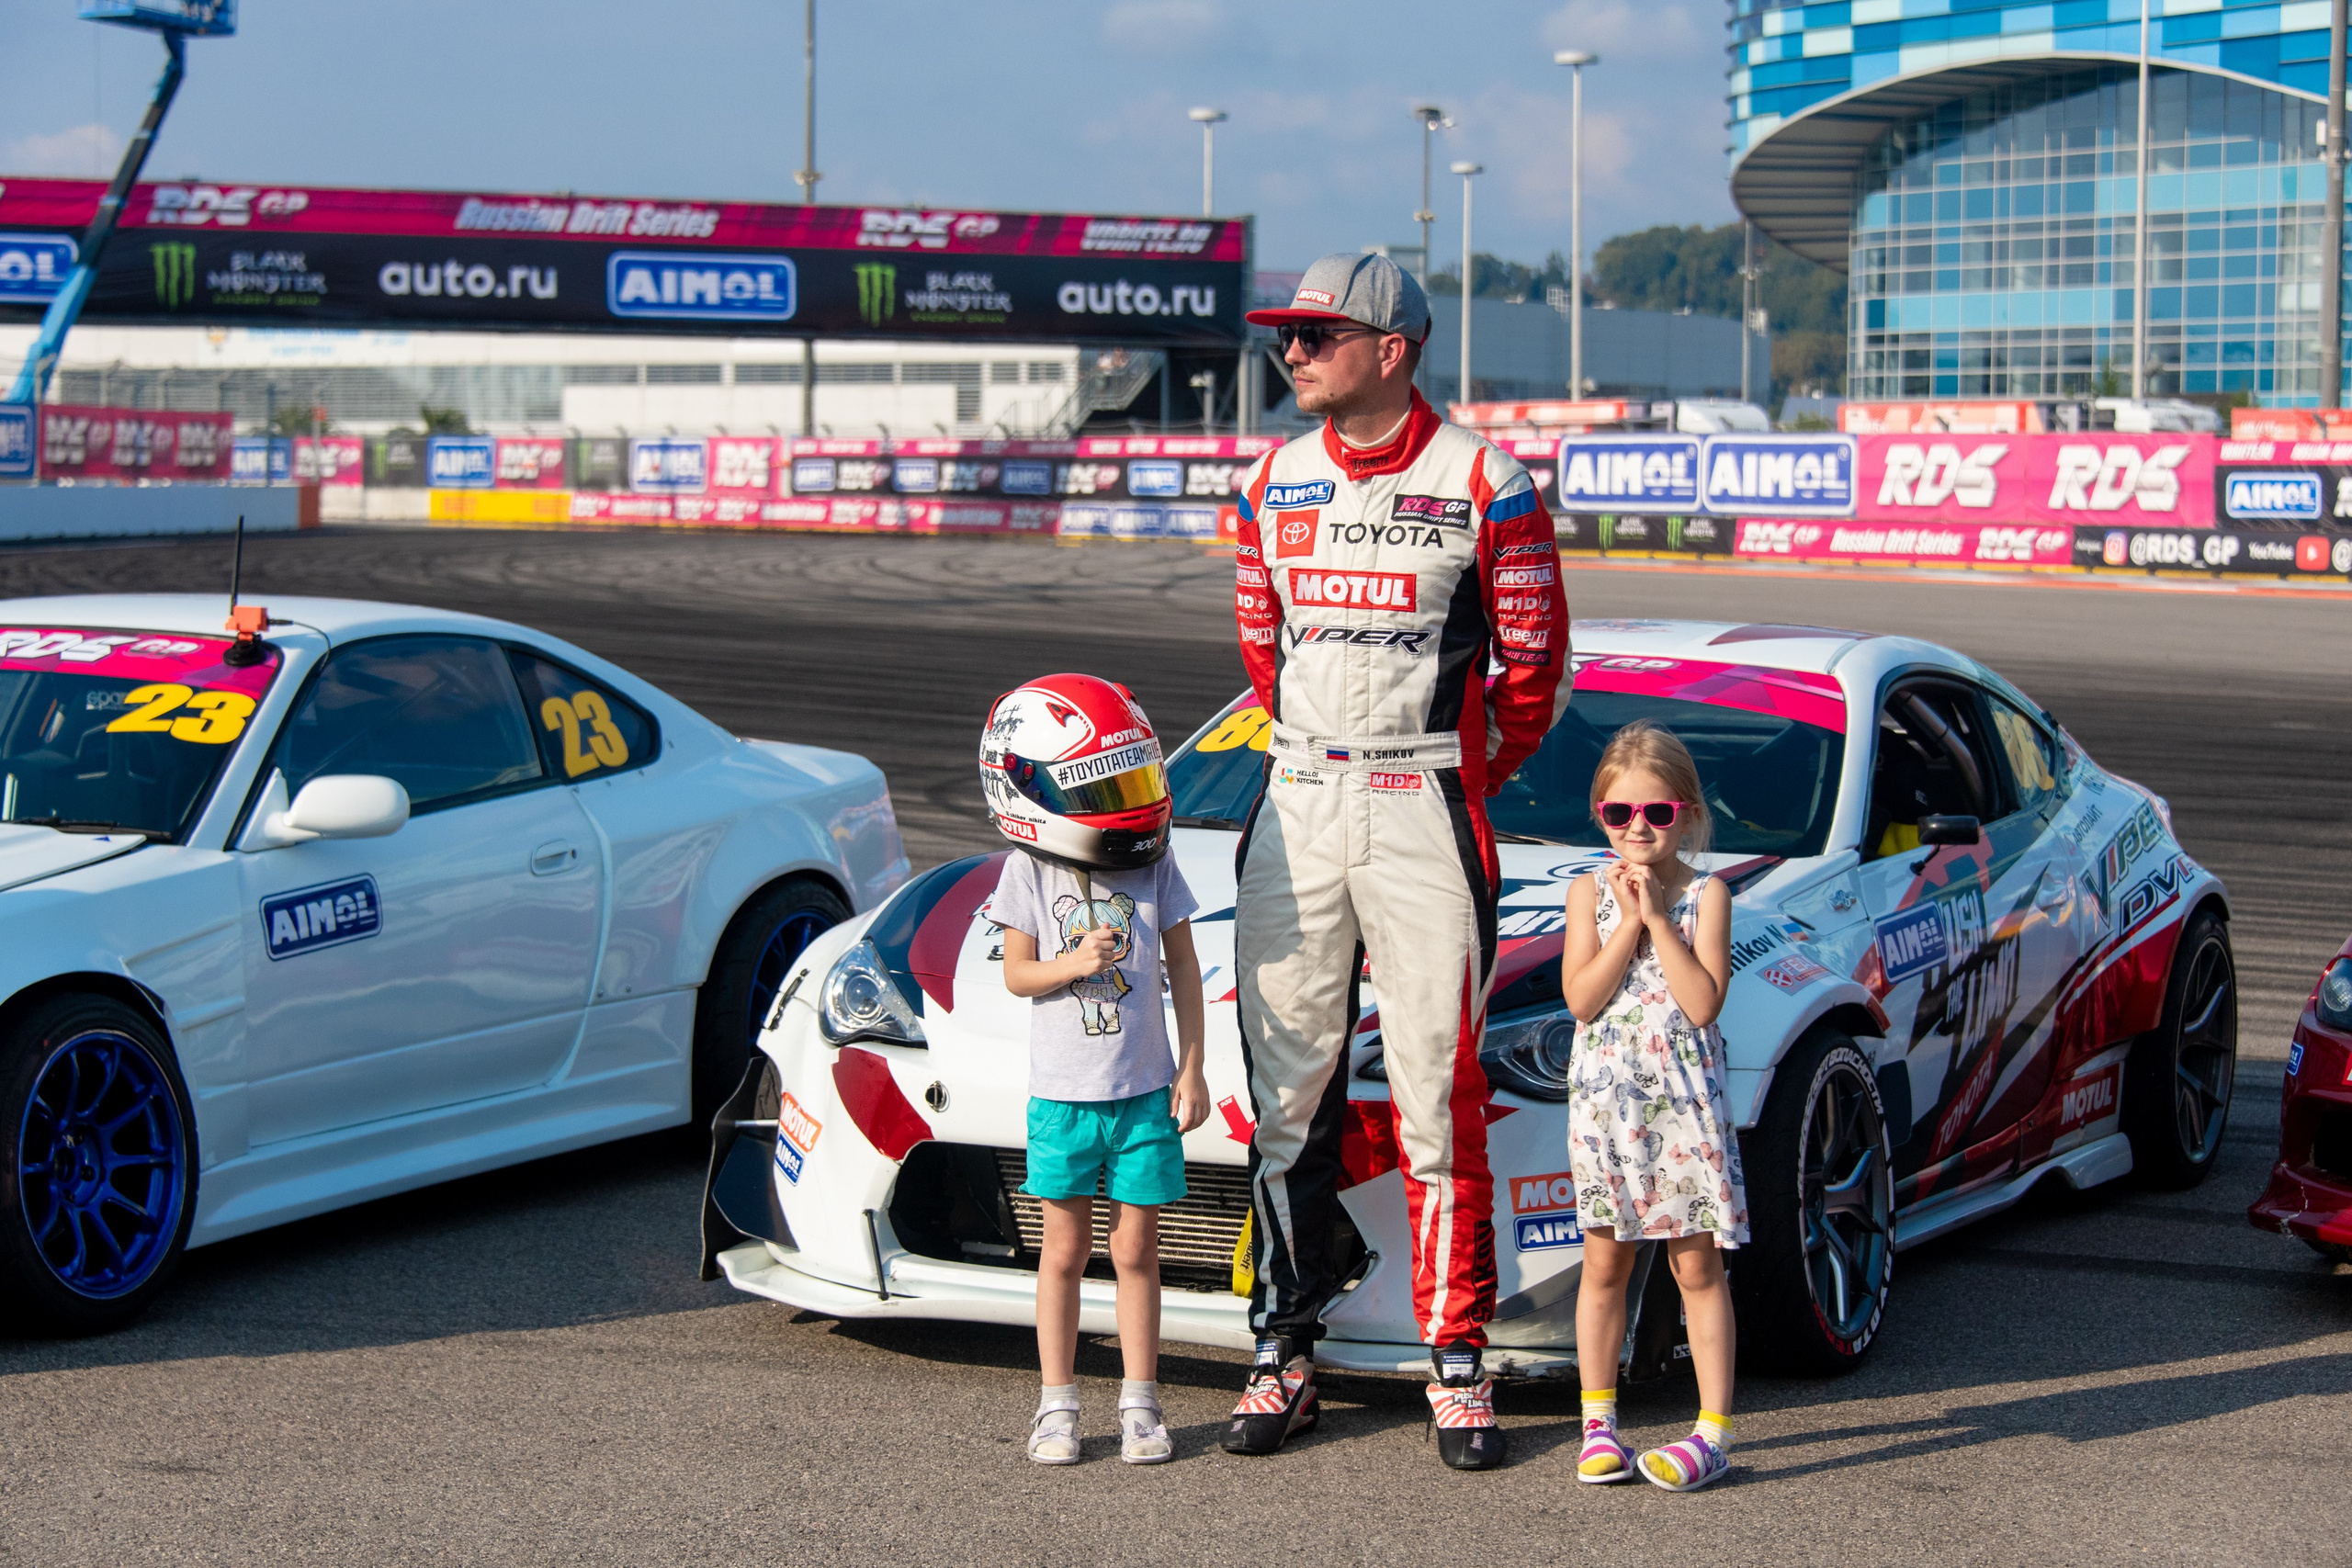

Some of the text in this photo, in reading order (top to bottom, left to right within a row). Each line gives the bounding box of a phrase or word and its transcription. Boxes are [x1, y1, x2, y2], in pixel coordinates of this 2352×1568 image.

[147, 187, 310, 225] RDS GP
[454, 197, 719, 237] Russian Drift Series
[856, 210, 1001, 248] RDS GP
[379, 258, 558, 299] auto.ru
[618, 268, 785, 306] AIMOL
[1057, 279, 1216, 317] auto.ru
[1297, 289, 1333, 306] MOTUL
[1351, 456, 1388, 471] freem
[1565, 451, 1696, 497] AIMOL
[1708, 452, 1849, 499] AIMOL
[1877, 443, 2009, 507] RDS
[2048, 445, 2192, 512] RDS
[1266, 486, 1328, 503] AIMOL
[1398, 497, 1469, 516] RDS GP
[2230, 481, 2315, 510] AIMOL
[1329, 522, 1443, 549] TOYOTA
[1423, 513, 1442, 524] DRIFT
[1443, 517, 1466, 525] SERIES
[1493, 542, 1554, 560] VIPER
[1739, 523, 1822, 553] RDS GP
[1830, 527, 1965, 556] Russian Drift Series
[1975, 526, 2067, 561] RDS GP
[2129, 532, 2240, 570] @RDS_GP
[2248, 541, 2295, 561] YouTube
[1295, 573, 1410, 606] MOTUL
[1498, 568, 1552, 585] MOTUL
[1498, 596, 1538, 611] M1D
[1498, 613, 1552, 621] RACING
[130, 637, 199, 656] GP
[1285, 622, 1432, 656] VIPER
[1498, 625, 1549, 643] freem
[1599, 657, 1675, 673] GP
[106, 682, 257, 745] 23
[540, 689, 629, 779] 23
[1101, 728, 1143, 749] MOTUL
[1296, 777, 1324, 786] KITCHEN
[1372, 774, 1405, 787] M1D
[272, 889, 377, 947] AIMOL
[1938, 888, 1987, 976] USH
[1729, 933, 1777, 978] hikov
[1883, 917, 1944, 970] AIMOL
[1936, 1050, 1994, 1156] TOYOTA
[2060, 1076, 2113, 1126] MOTUL
[780, 1097, 819, 1151] MOTUL
[775, 1137, 800, 1177] AIMOL
[1518, 1177, 1577, 1210] MO
[1521, 1220, 1585, 1245] AIM
[1453, 1392, 1475, 1403] PUSH
[1467, 1399, 1487, 1408] LIMIT
